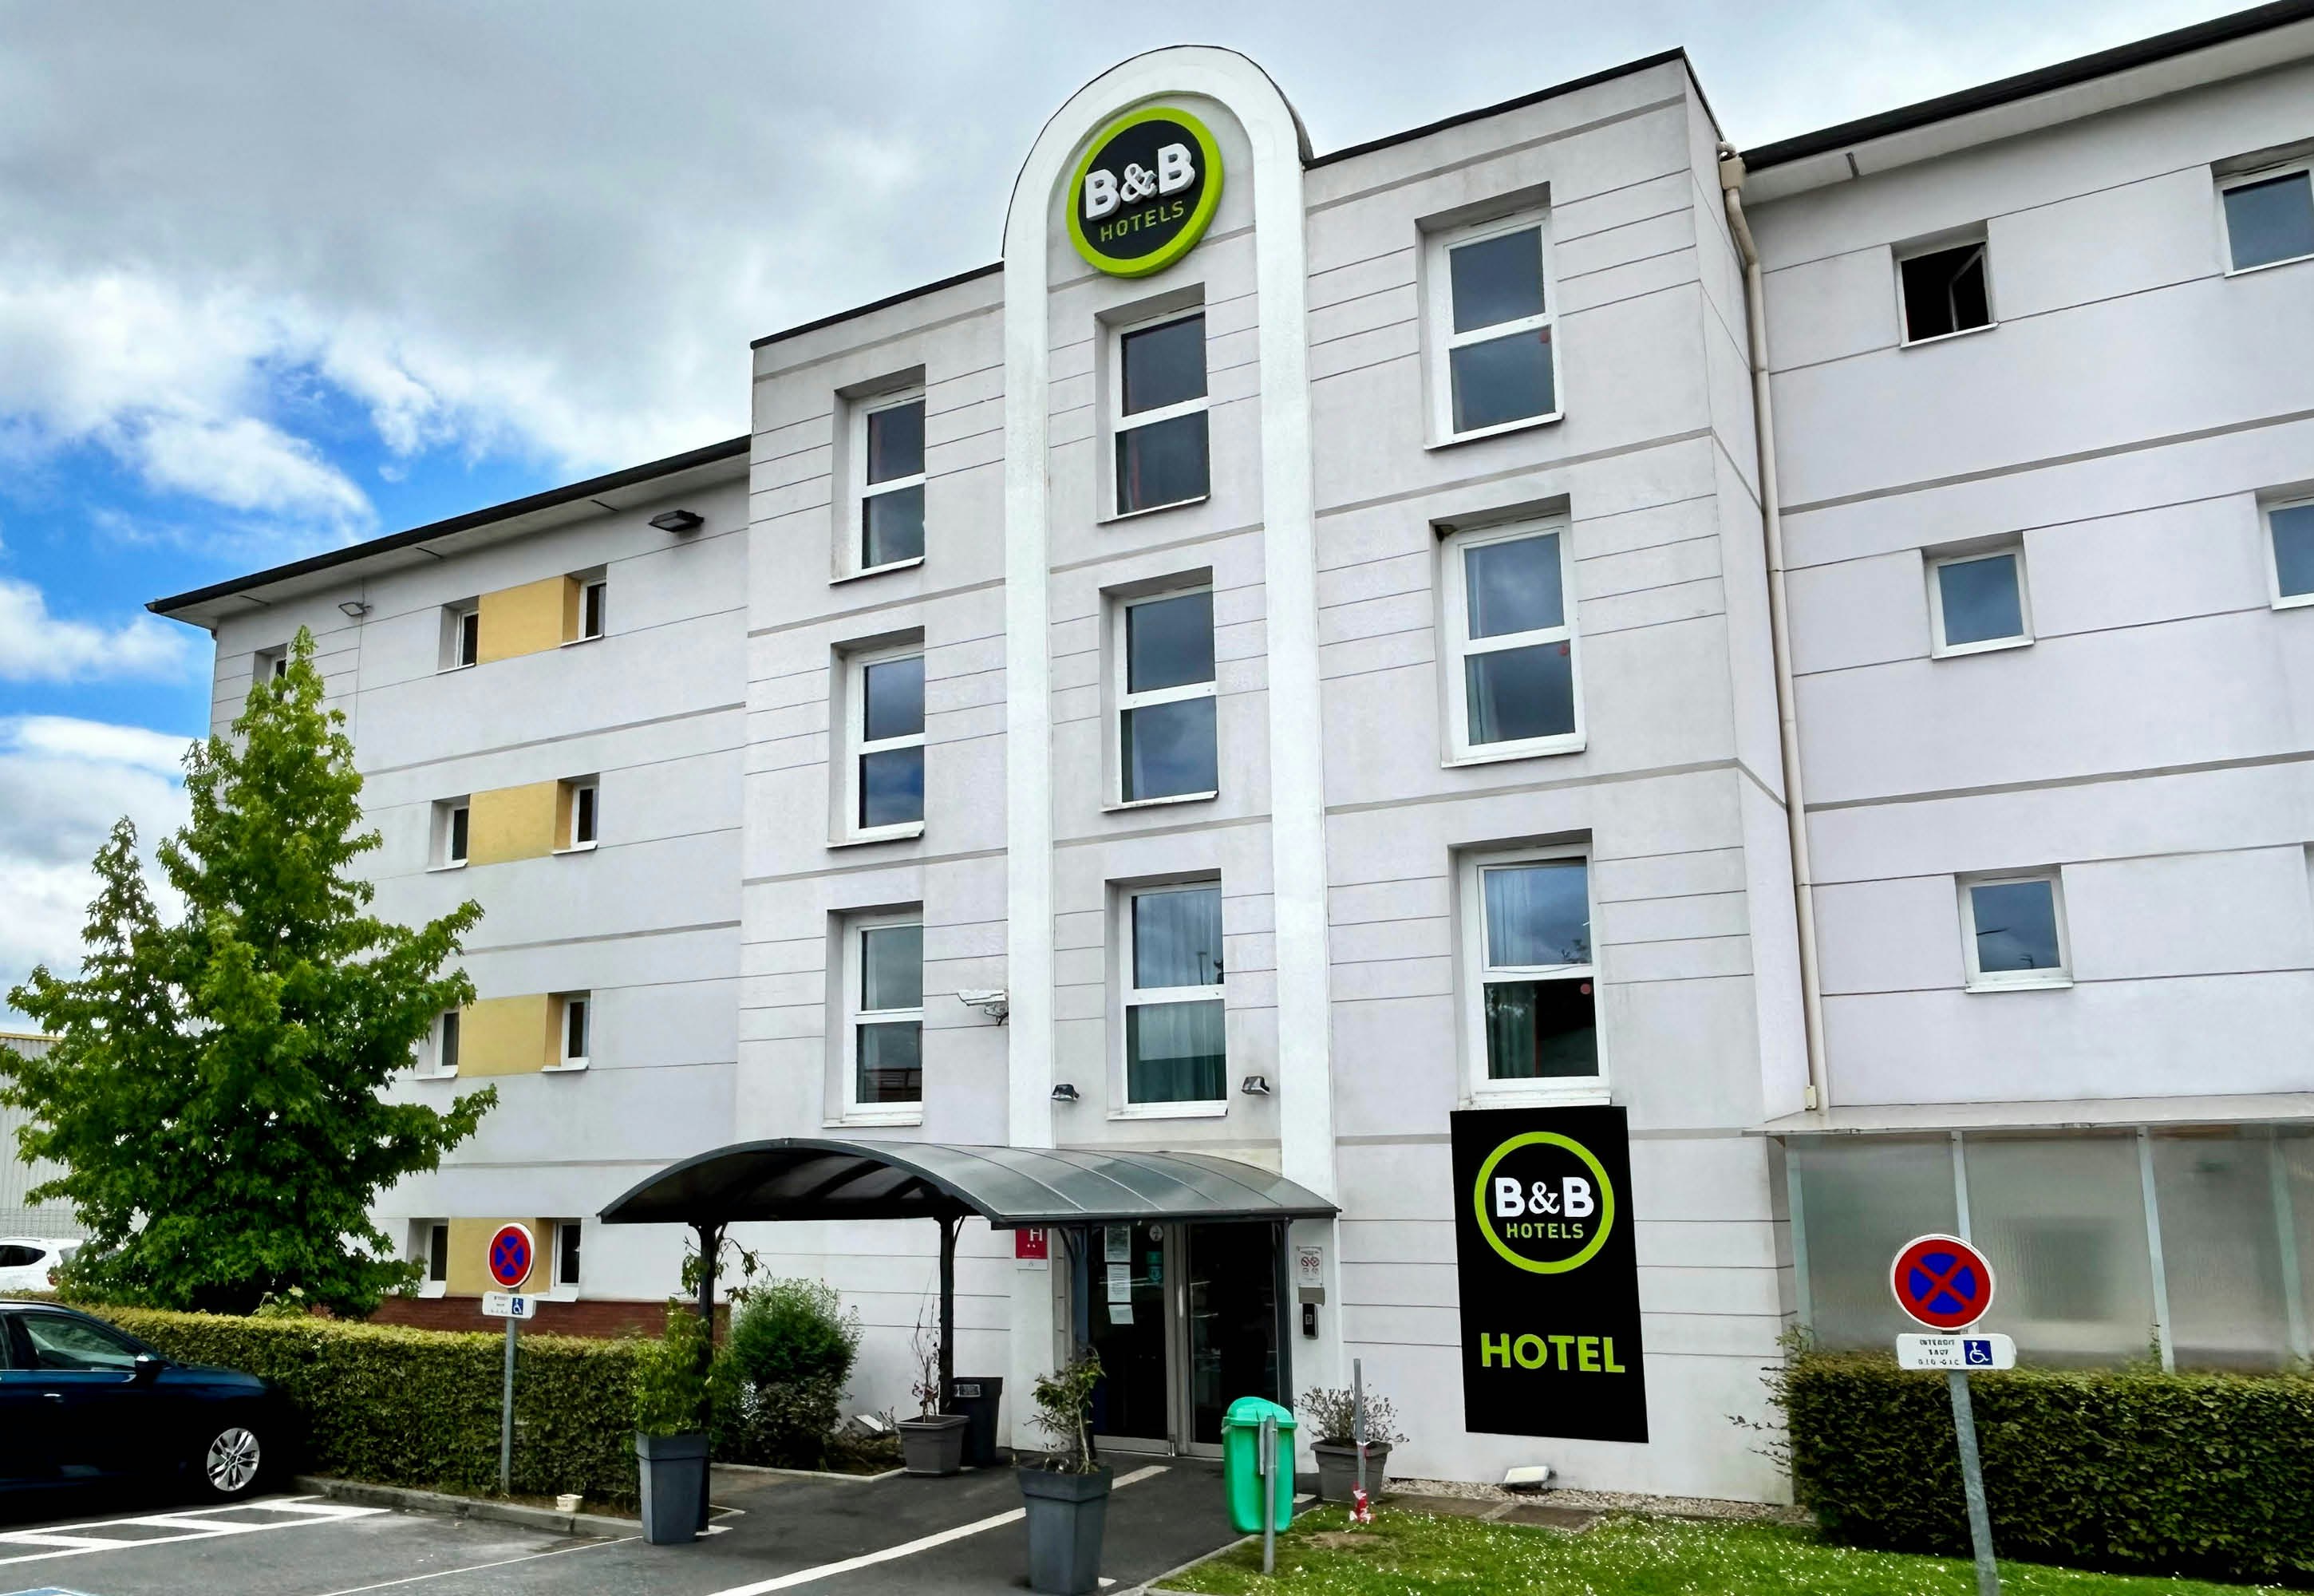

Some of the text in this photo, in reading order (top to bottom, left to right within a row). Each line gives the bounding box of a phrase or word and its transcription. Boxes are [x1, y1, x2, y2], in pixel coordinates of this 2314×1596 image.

[1085, 143, 1195, 221] B&B
[1100, 200, 1185, 242] HOTELS
[1495, 1176, 1594, 1218] B&B
[1029, 1228, 1043, 1242] H
[1506, 1223, 1584, 1239] HOTELS
[1480, 1332, 1625, 1373] HOTEL
